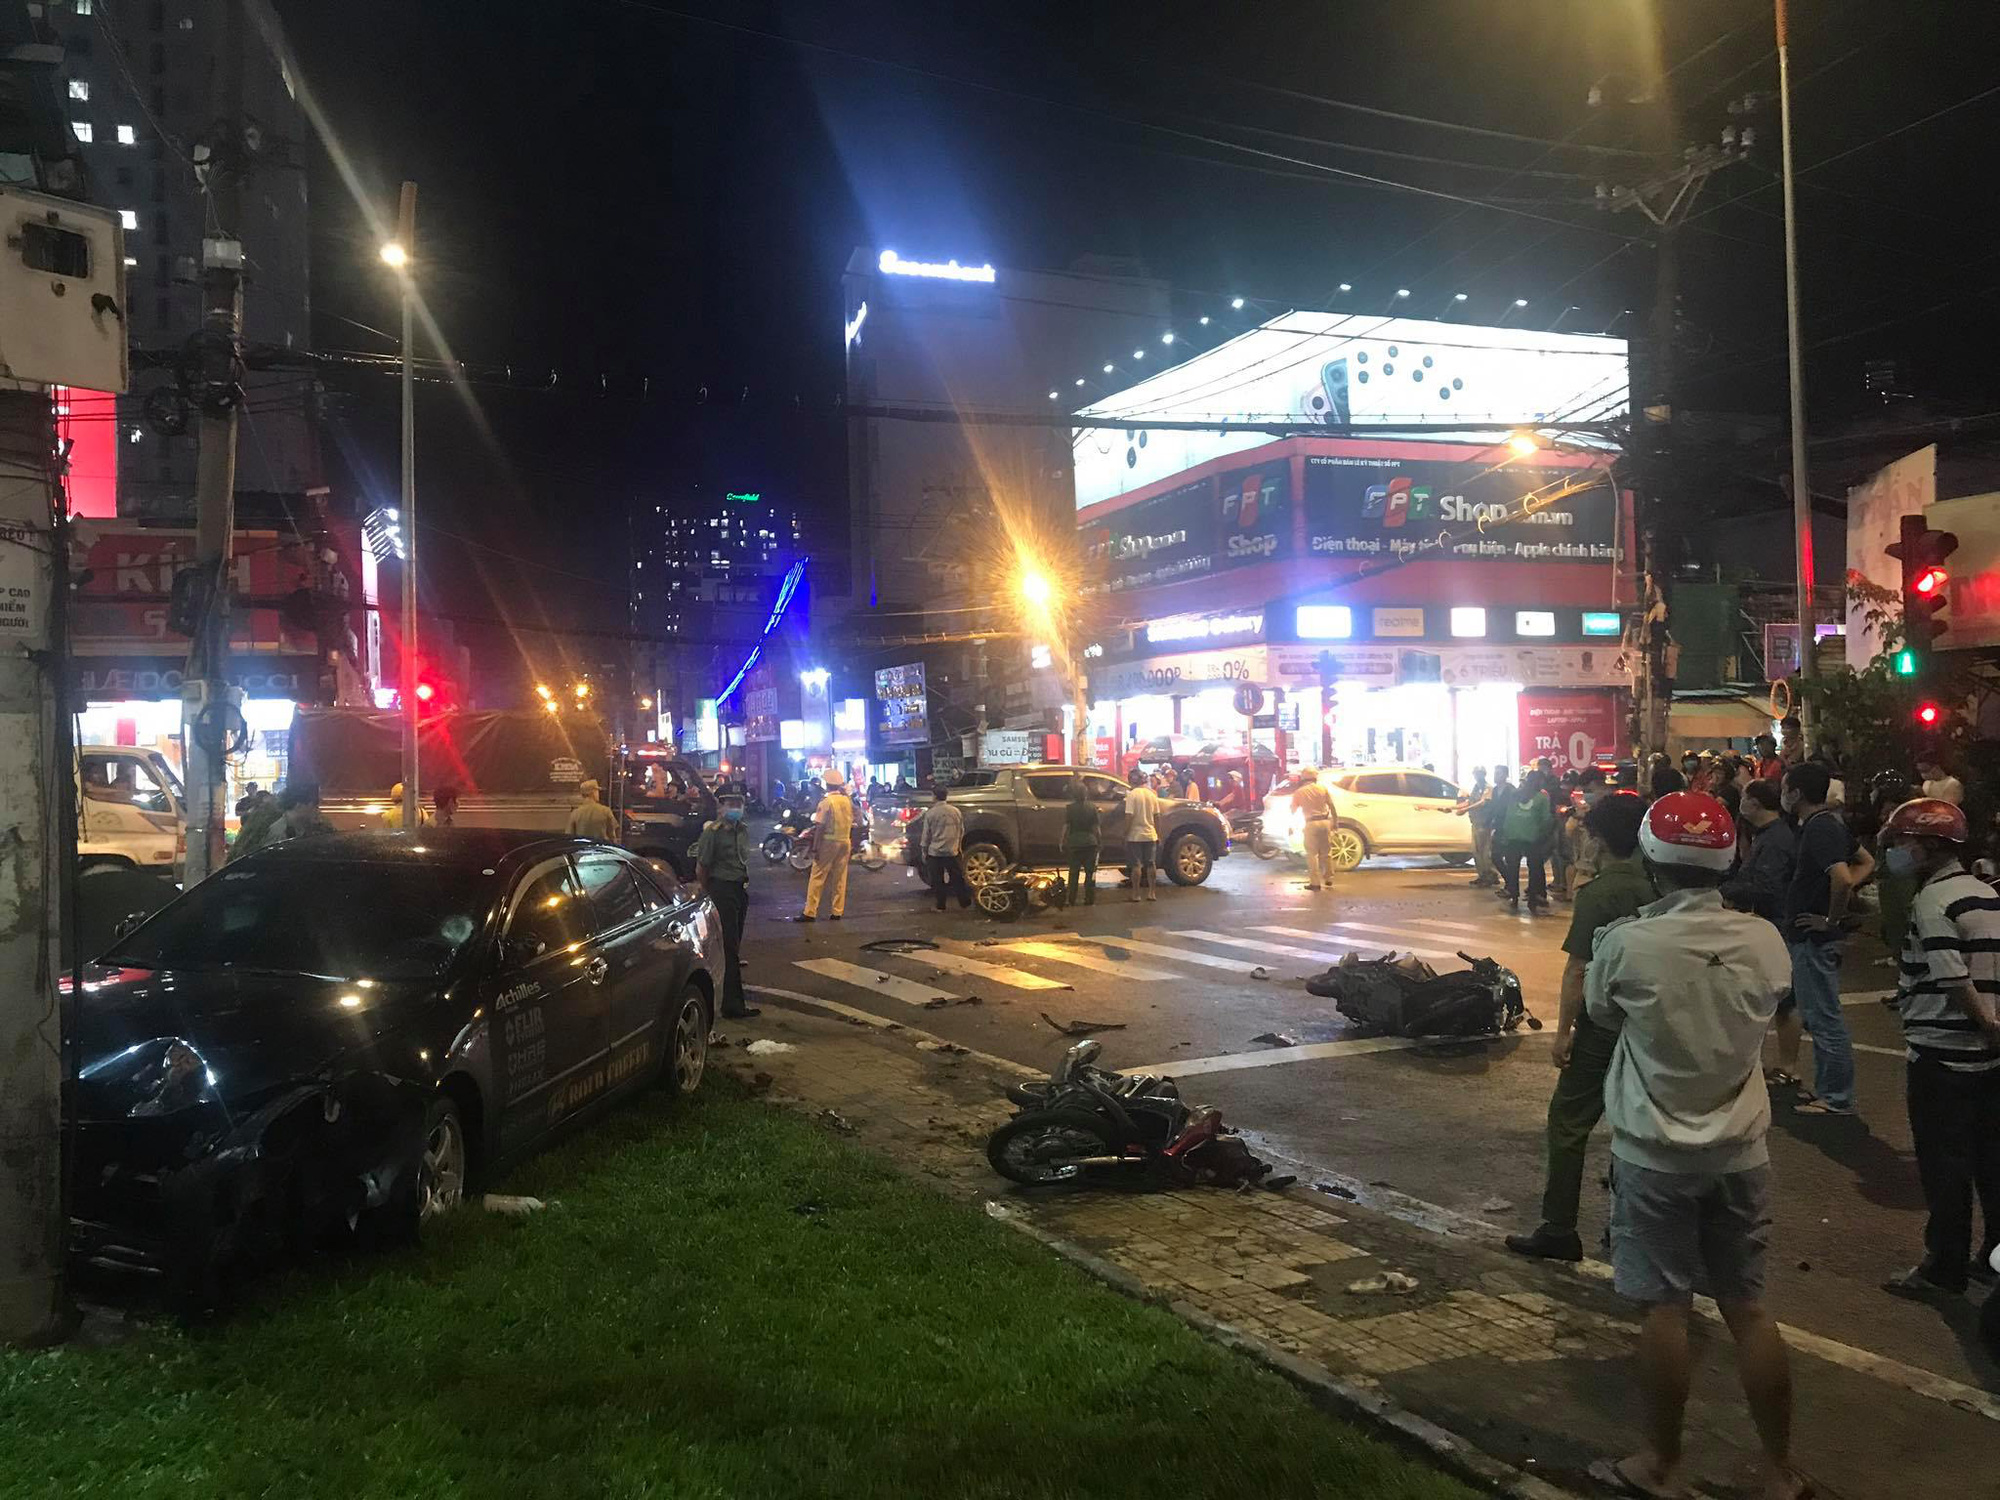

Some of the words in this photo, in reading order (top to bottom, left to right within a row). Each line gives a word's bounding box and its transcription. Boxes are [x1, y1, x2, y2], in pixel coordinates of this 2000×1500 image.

[1223, 486, 1275, 516] FPT
[1366, 491, 1430, 512] FPT
[1228, 533, 1278, 557] Shop
[1312, 536, 1344, 554] Điện
[1345, 537, 1380, 555] thoại
[1515, 542, 1550, 558] Apple
[1552, 543, 1588, 557] chính
[1223, 660, 1250, 681] 0%
[1535, 731, 1562, 750] TRẢ
[495, 981, 542, 1011] Achilles
